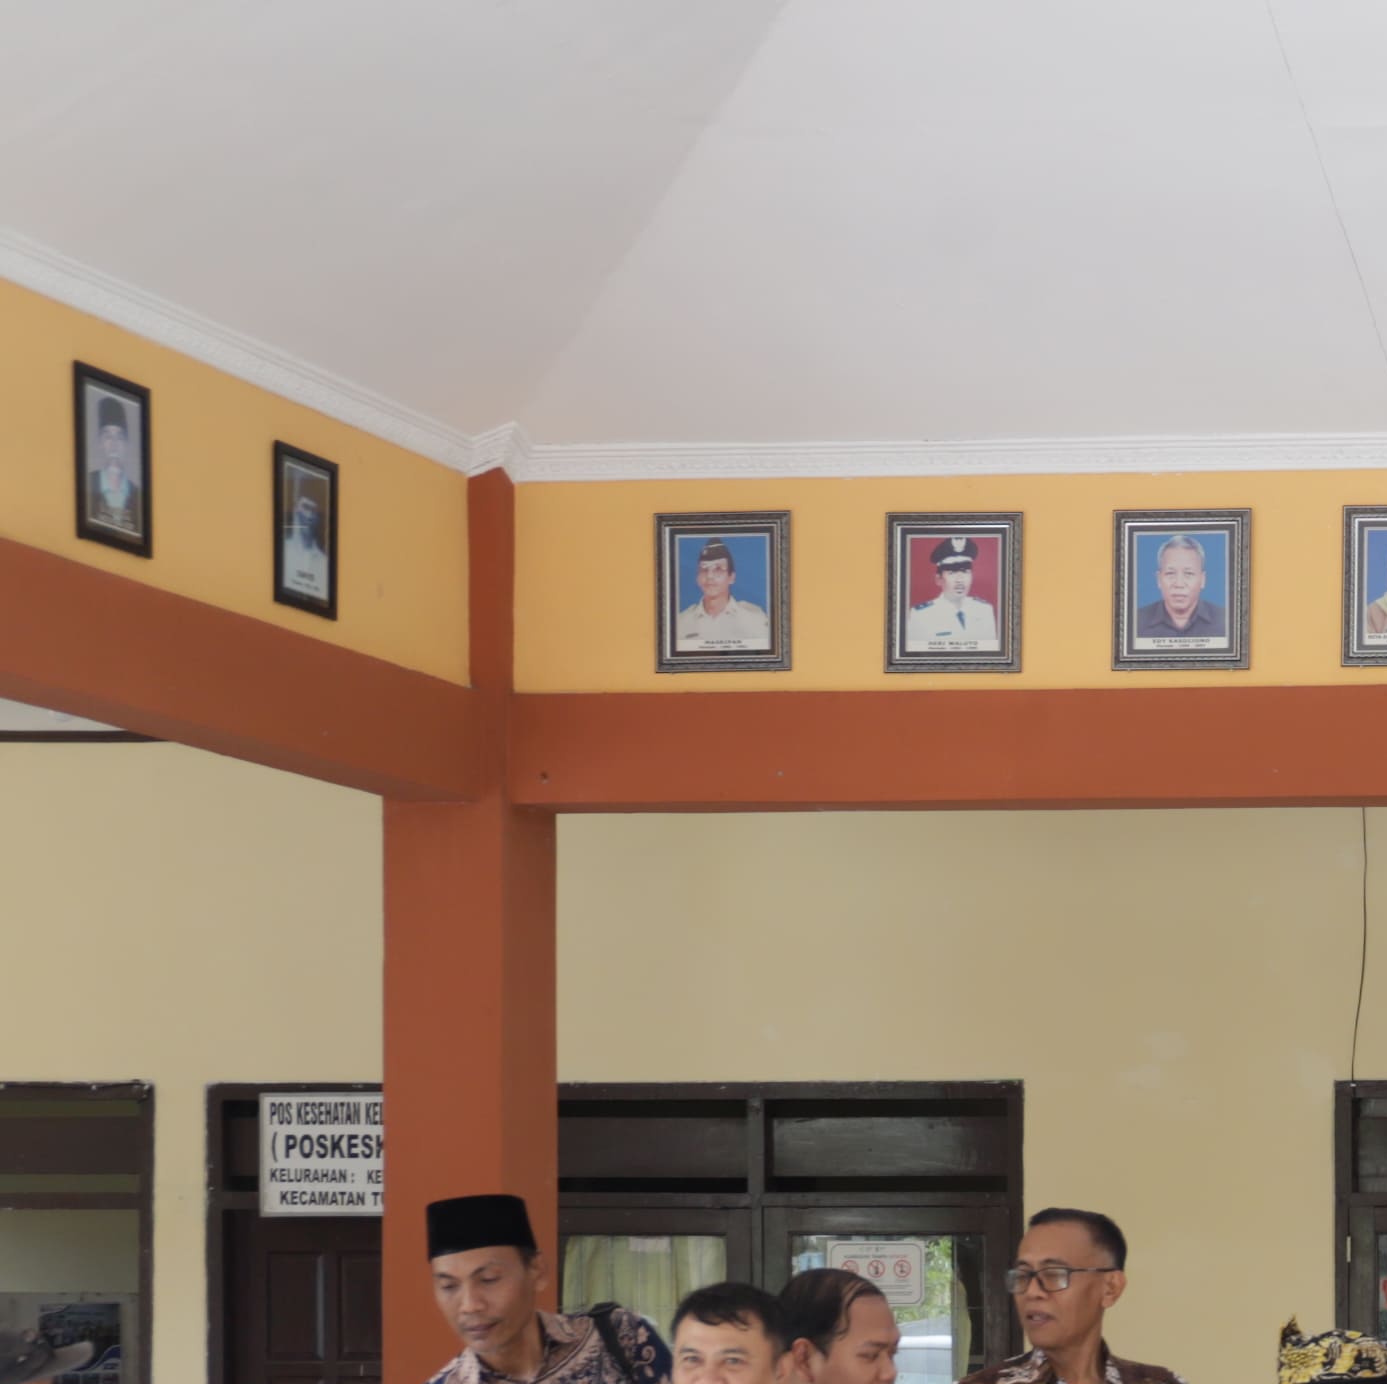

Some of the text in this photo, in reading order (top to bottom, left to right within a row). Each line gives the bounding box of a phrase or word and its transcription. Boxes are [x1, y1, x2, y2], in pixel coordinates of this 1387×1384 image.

[270, 1101, 292, 1125] POS
[296, 1101, 361, 1125] KESEHATAN
[270, 1168, 347, 1183] KELURAHAN
[280, 1190, 365, 1206] KECAMATAN
